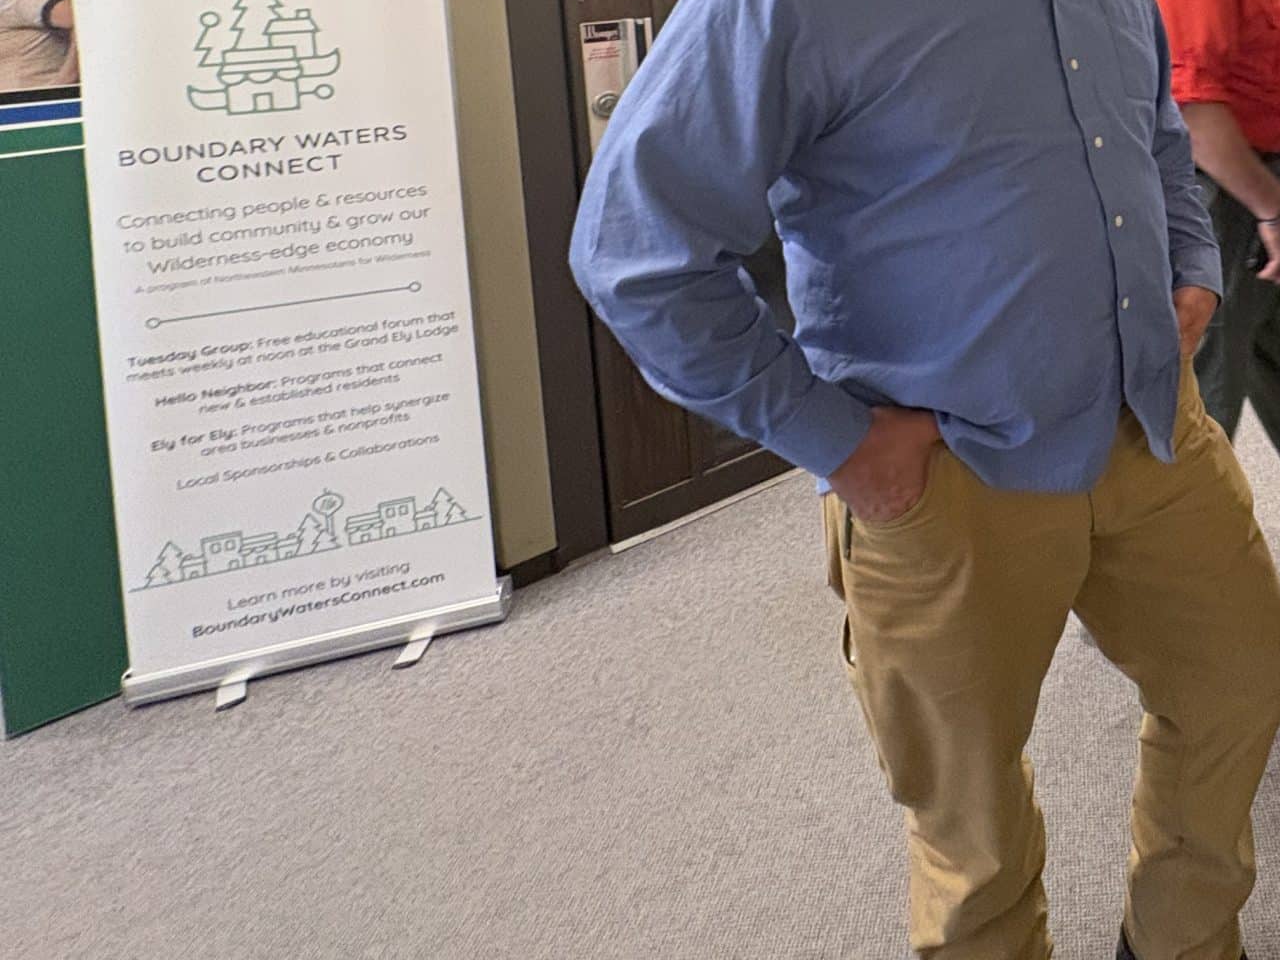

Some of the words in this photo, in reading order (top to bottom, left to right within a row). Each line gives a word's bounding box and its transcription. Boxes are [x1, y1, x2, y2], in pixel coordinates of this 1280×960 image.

[118, 136, 286, 167] BOUNDARY
[294, 124, 408, 151] WATERS
[196, 154, 343, 183] CONNECT
[117, 204, 236, 230] Connecting
[242, 196, 310, 219] people
[315, 193, 330, 208] &
[335, 185, 428, 206] resources
[123, 241, 145, 254] to
[151, 229, 202, 250] build
[208, 218, 321, 243] community
[326, 214, 340, 229] &
[345, 212, 394, 230] grow
[399, 207, 431, 222] our
[147, 244, 320, 274] Wilderness-edge
[326, 232, 414, 252] economy
[126, 368, 174, 382] meets
[180, 358, 234, 374] weekly
[237, 355, 252, 366] at
[256, 351, 295, 364] noon
[298, 346, 313, 357] at
[318, 342, 341, 353] the
[344, 332, 388, 349] Grand
[391, 330, 412, 343] Ely
[416, 324, 460, 339] Lodge
[127, 349, 196, 368] Tuesday
[201, 341, 253, 357] Group:
[256, 336, 291, 348] Free
[294, 321, 378, 343] educational
[382, 316, 424, 330] forum
[427, 311, 455, 322] that
[155, 392, 197, 407] Hello
[201, 379, 277, 399] Neighbor:
[280, 366, 353, 386] Programs
[356, 361, 385, 374] that
[388, 353, 443, 370] connect
[199, 401, 230, 414] new
[234, 397, 246, 409] &
[250, 384, 332, 406] established
[336, 373, 401, 391] residents
[151, 439, 176, 452] Ely
[181, 434, 205, 446] for
[209, 428, 238, 441] Ely:
[241, 414, 315, 435] Programs
[318, 408, 346, 421] that
[350, 404, 381, 417] help
[384, 393, 451, 412] synergize
[200, 443, 237, 457] area
[240, 427, 320, 450] businesses
[324, 424, 335, 436] &
[338, 412, 411, 433] nonprofits
[176, 472, 220, 491] Local
[223, 455, 321, 483] Sponsorships
[324, 451, 336, 464] &
[339, 433, 441, 461] Collaborations
[191, 572, 445, 638] BoundaryWatersConnect.com
[227, 591, 278, 612] Learn
[281, 581, 326, 599] more
[331, 571, 351, 588] by
[354, 561, 410, 582] visiting
